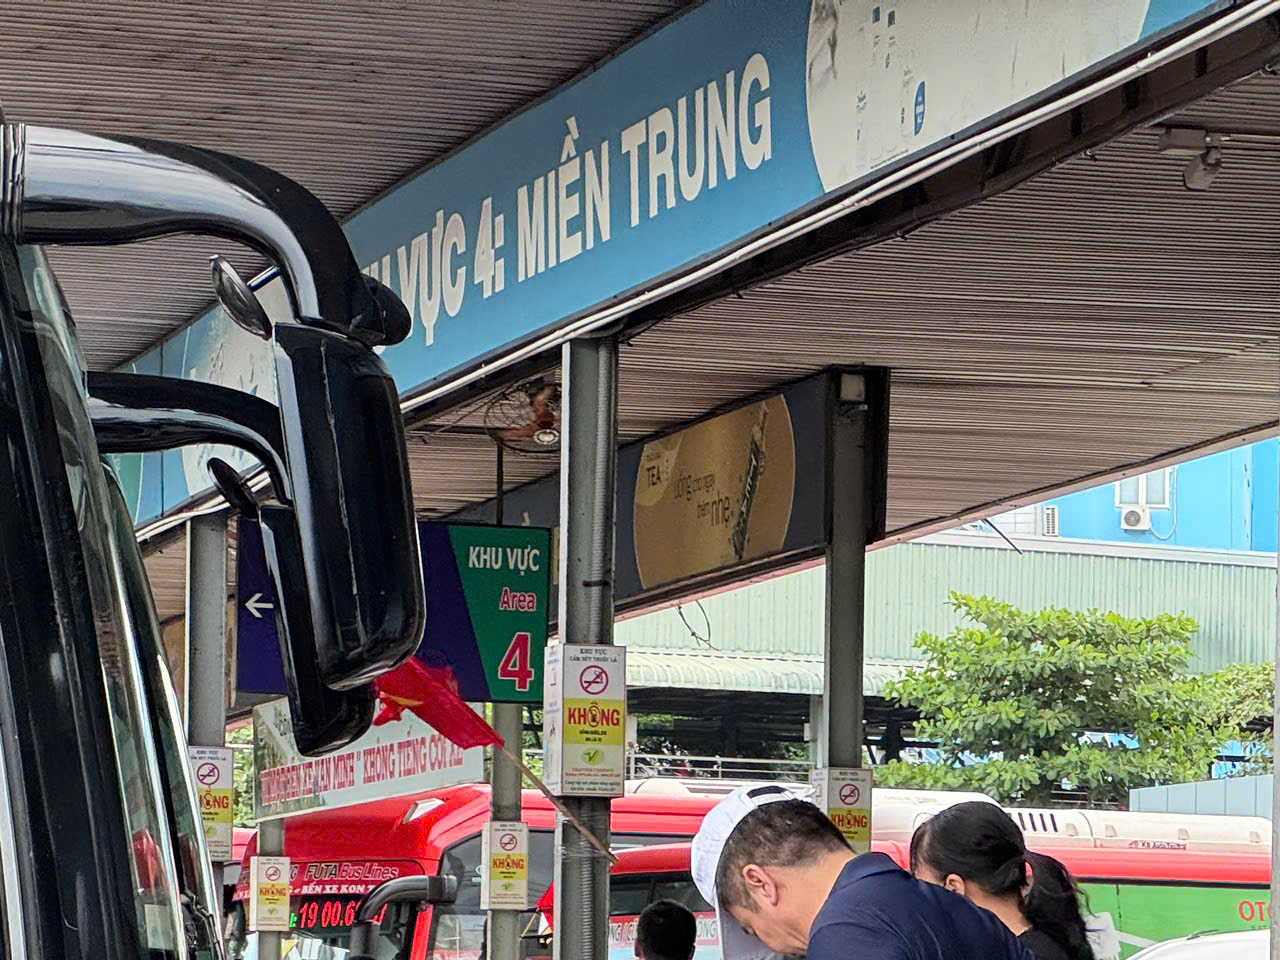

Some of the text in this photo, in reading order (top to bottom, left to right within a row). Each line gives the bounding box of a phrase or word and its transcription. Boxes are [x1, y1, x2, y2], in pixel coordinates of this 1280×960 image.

[398, 207, 467, 346] VỰC
[517, 116, 611, 283] MIỀN
[621, 53, 772, 228] TRUNG
[468, 545, 541, 577] KHU VỰC
[499, 586, 537, 612] Area
[498, 632, 535, 692] 4
[568, 701, 620, 728] KHÔNG
[305, 864, 339, 880] FUTA
